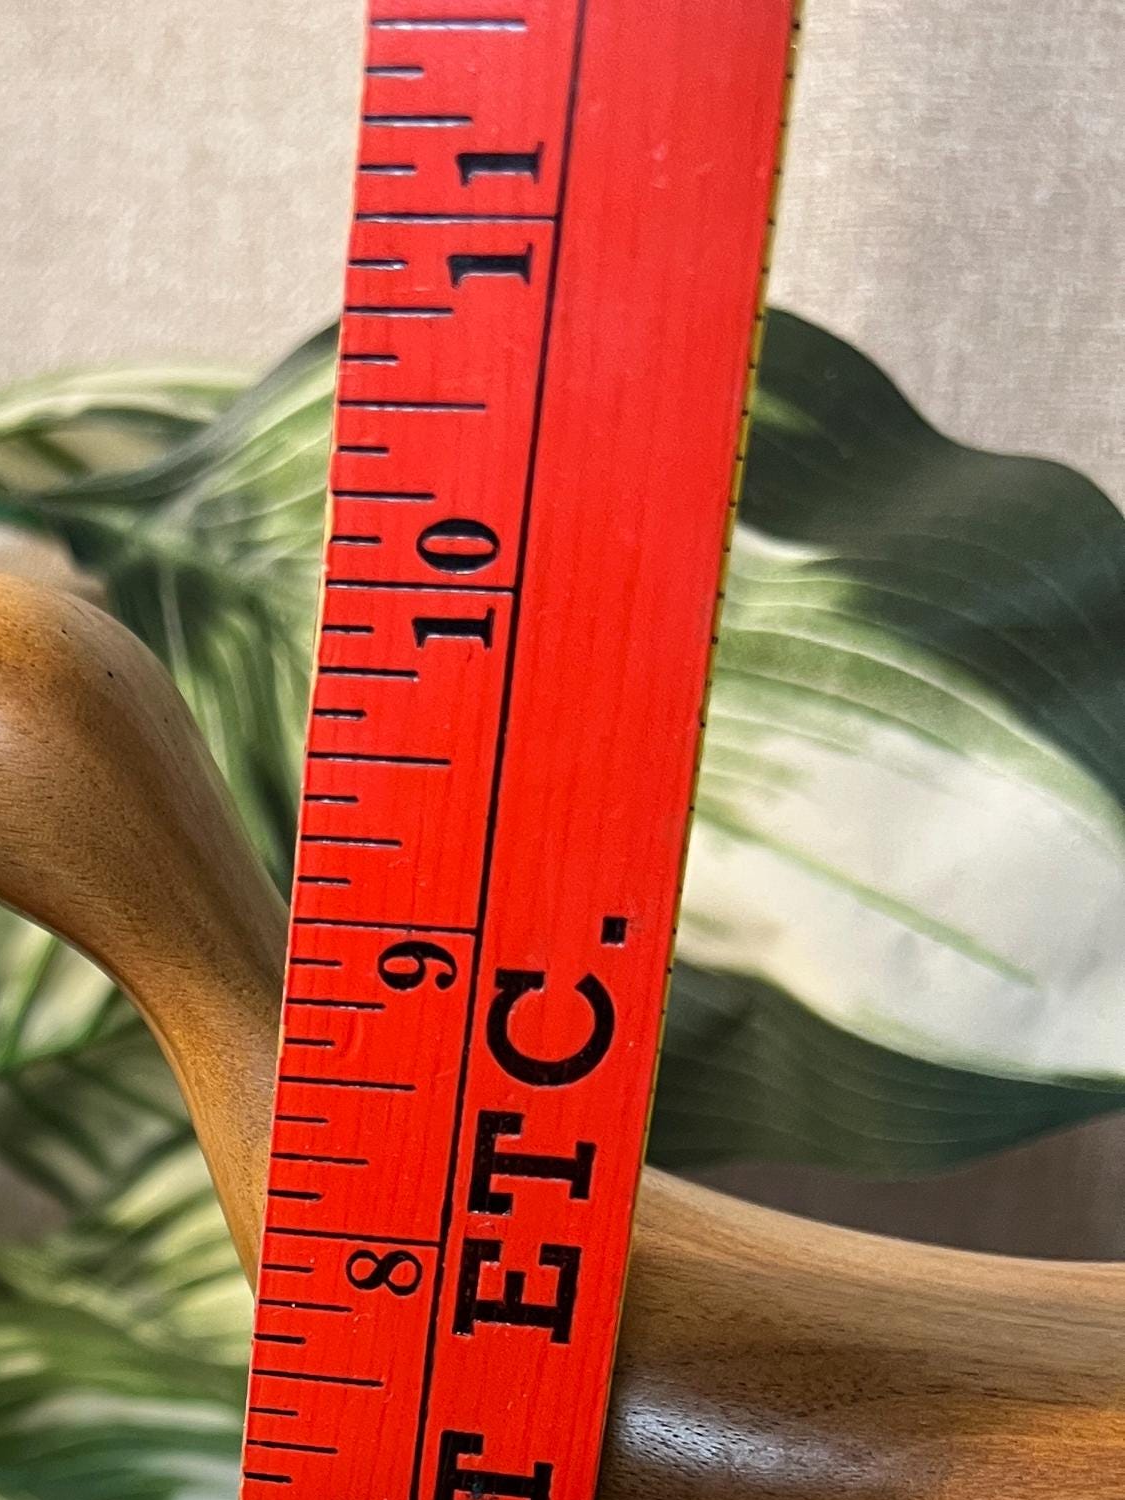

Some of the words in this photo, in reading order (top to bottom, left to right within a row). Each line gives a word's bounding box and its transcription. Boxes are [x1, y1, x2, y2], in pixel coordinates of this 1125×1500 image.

[447, 142, 544, 288] 11
[412, 518, 501, 650] 10
[377, 940, 458, 991] 9
[452, 915, 628, 1345] ETC.
[345, 1249, 423, 1297] 8
